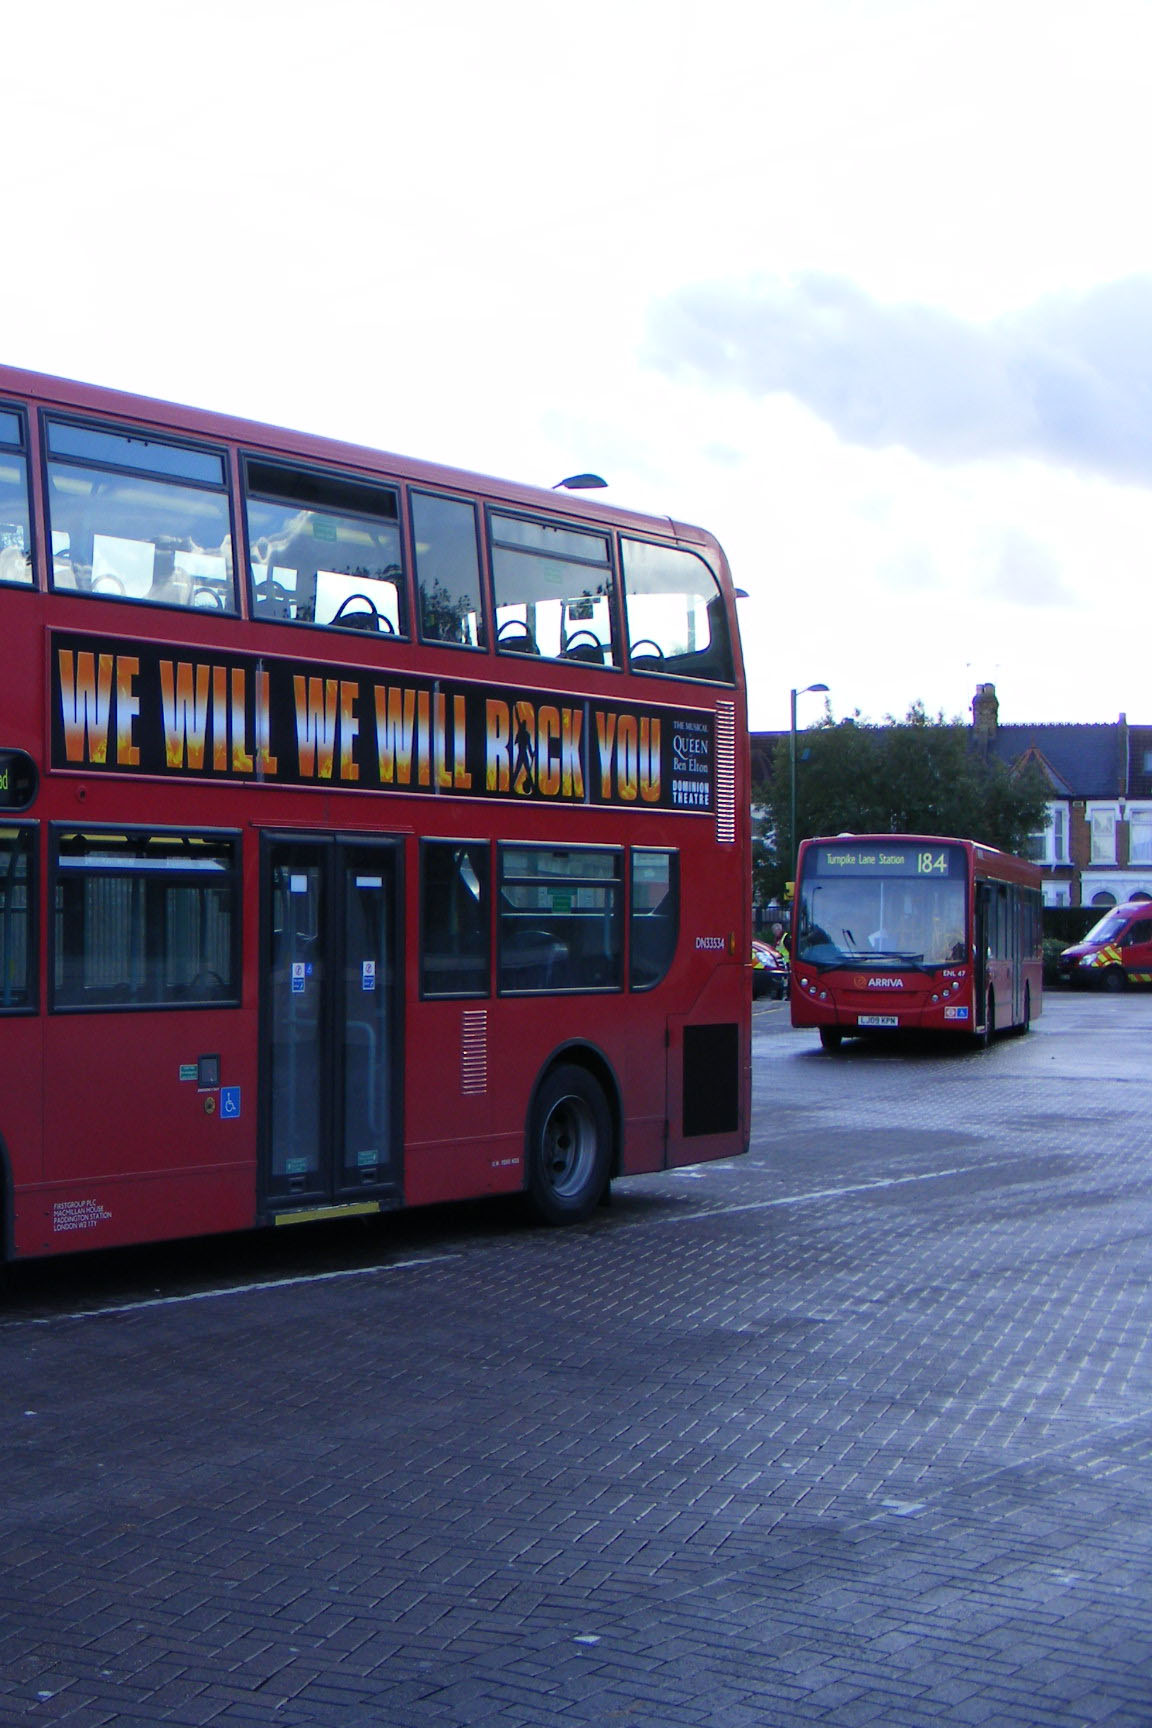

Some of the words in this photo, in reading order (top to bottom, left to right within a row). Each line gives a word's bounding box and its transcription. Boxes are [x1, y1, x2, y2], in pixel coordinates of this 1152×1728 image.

[58, 649, 140, 766] WE
[159, 659, 278, 774] WILL
[293, 674, 359, 780] WE
[374, 684, 472, 789] WILL
[486, 697, 584, 797] ROCK
[595, 711, 661, 802] YOU
[673, 734, 708, 760] QUEEN
[673, 757, 686, 772] Ben
[688, 759, 708, 773] Elton
[672, 780, 709, 793] DOMINION
[672, 792, 709, 805] THEATRE
[827, 853, 856, 867] Turnpike
[858, 853, 876, 865] Lane
[878, 853, 905, 865] Station
[917, 852, 948, 873] 184
[696, 937, 725, 949] DN33534
[868, 978, 904, 988] ARRIVA
[53, 1201, 85, 1210] FIRSTGROUP
[85, 1205, 104, 1213] HOUSE
[53, 1214, 89, 1224] PADDINGTON
[89, 1211, 112, 1220] STATION
[53, 1222, 78, 1232] LONDON
